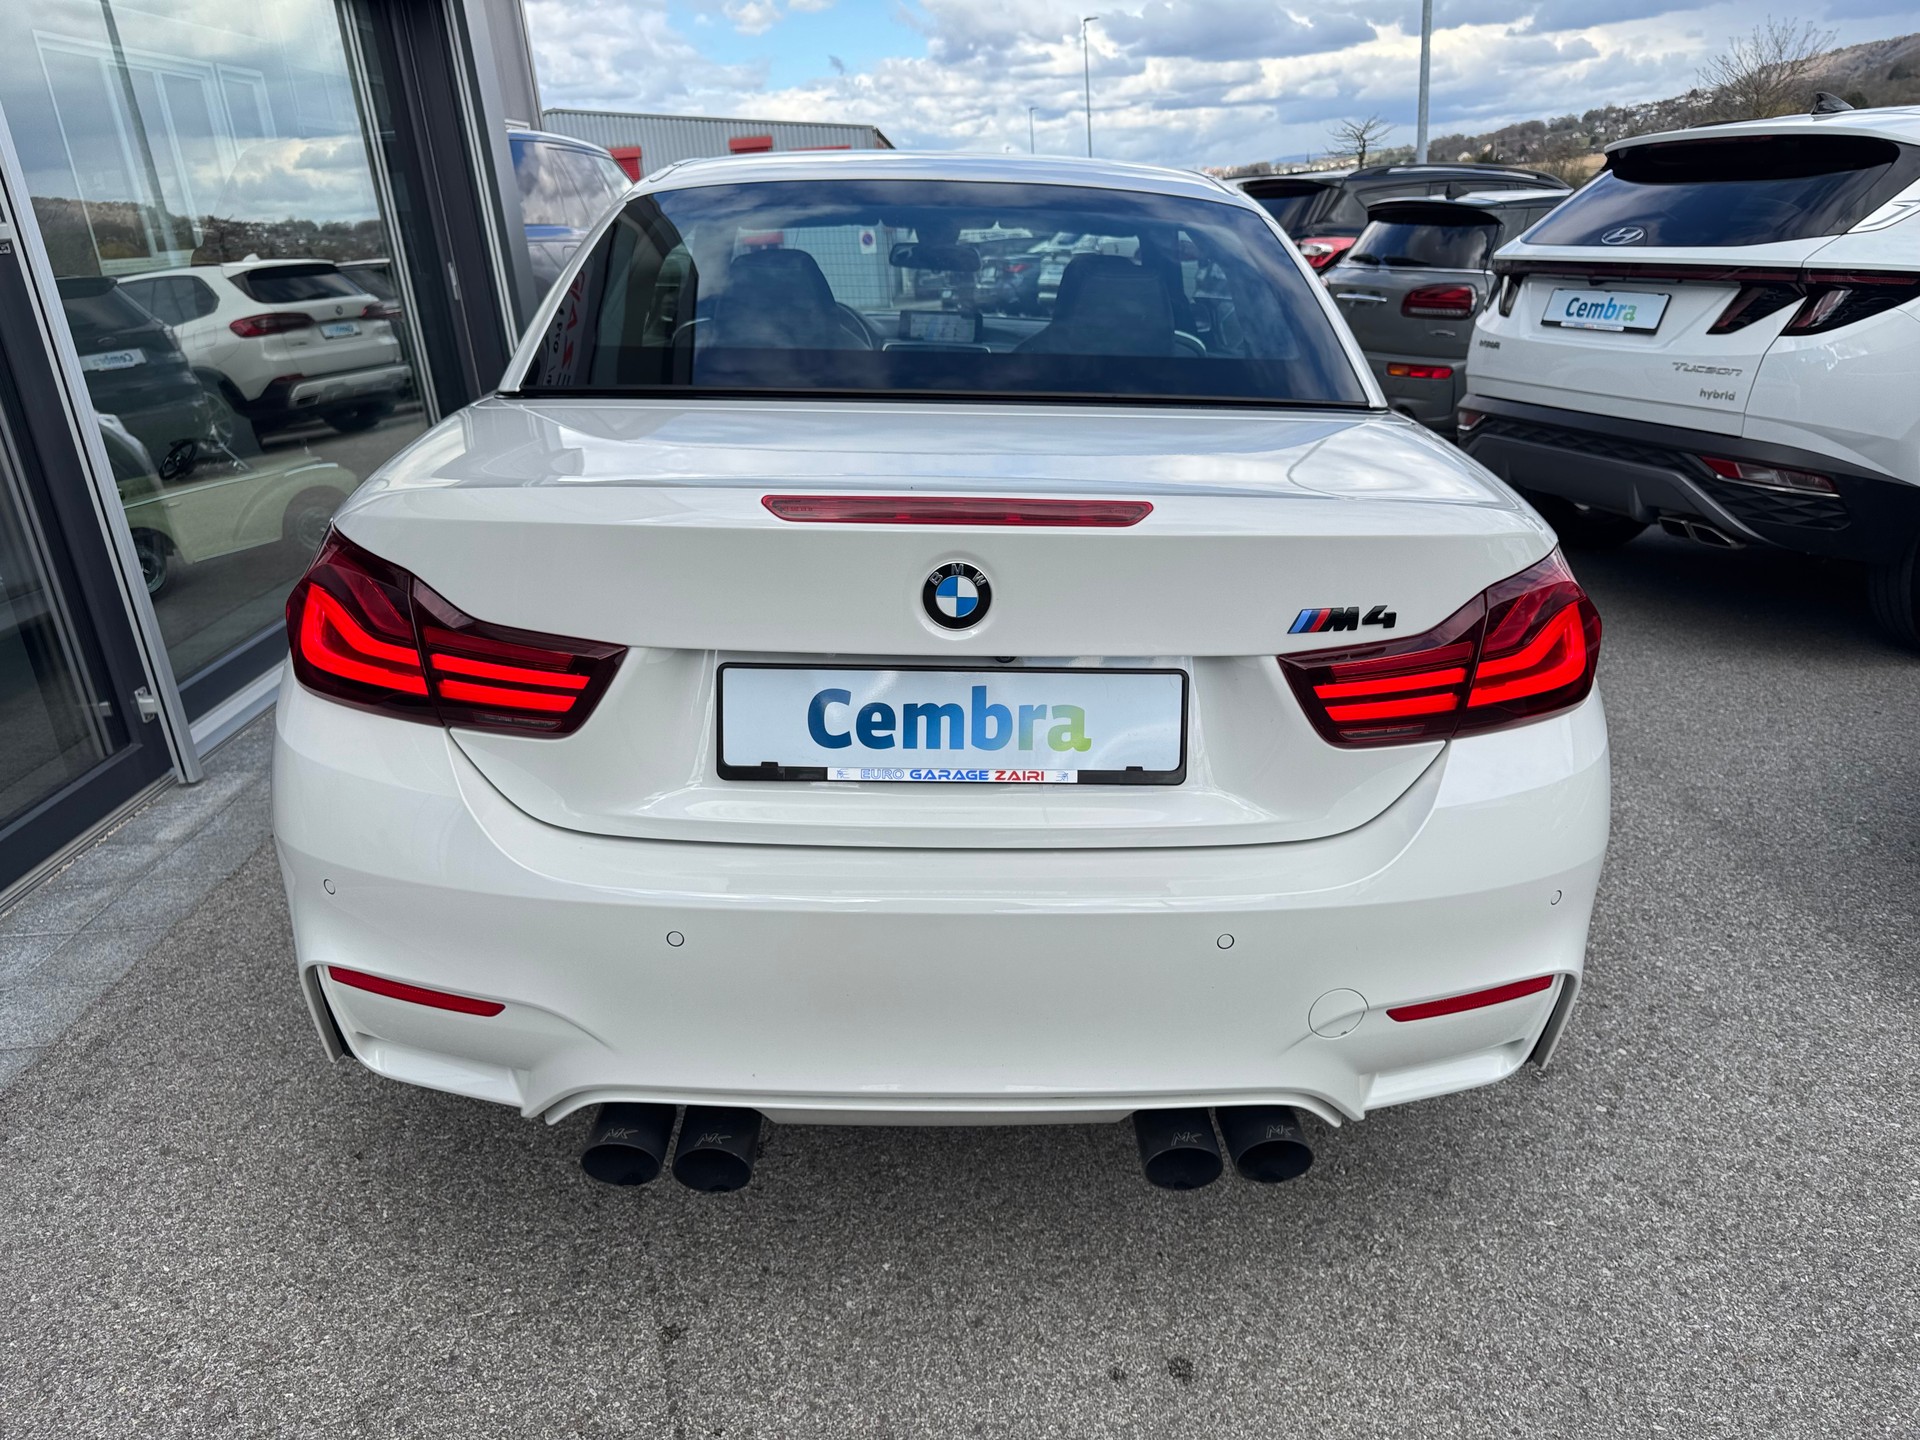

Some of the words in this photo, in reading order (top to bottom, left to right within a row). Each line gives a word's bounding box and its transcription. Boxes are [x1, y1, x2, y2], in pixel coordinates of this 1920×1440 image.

[1565, 297, 1638, 321] Cembra
[1699, 388, 1736, 401] hybrid
[928, 563, 987, 587] BMW
[1316, 605, 1397, 632] M4
[807, 685, 1092, 753] Cembra
[860, 768, 904, 780] EURO
[909, 769, 989, 781] GARAGE
[994, 770, 1045, 782] ZAIRI
